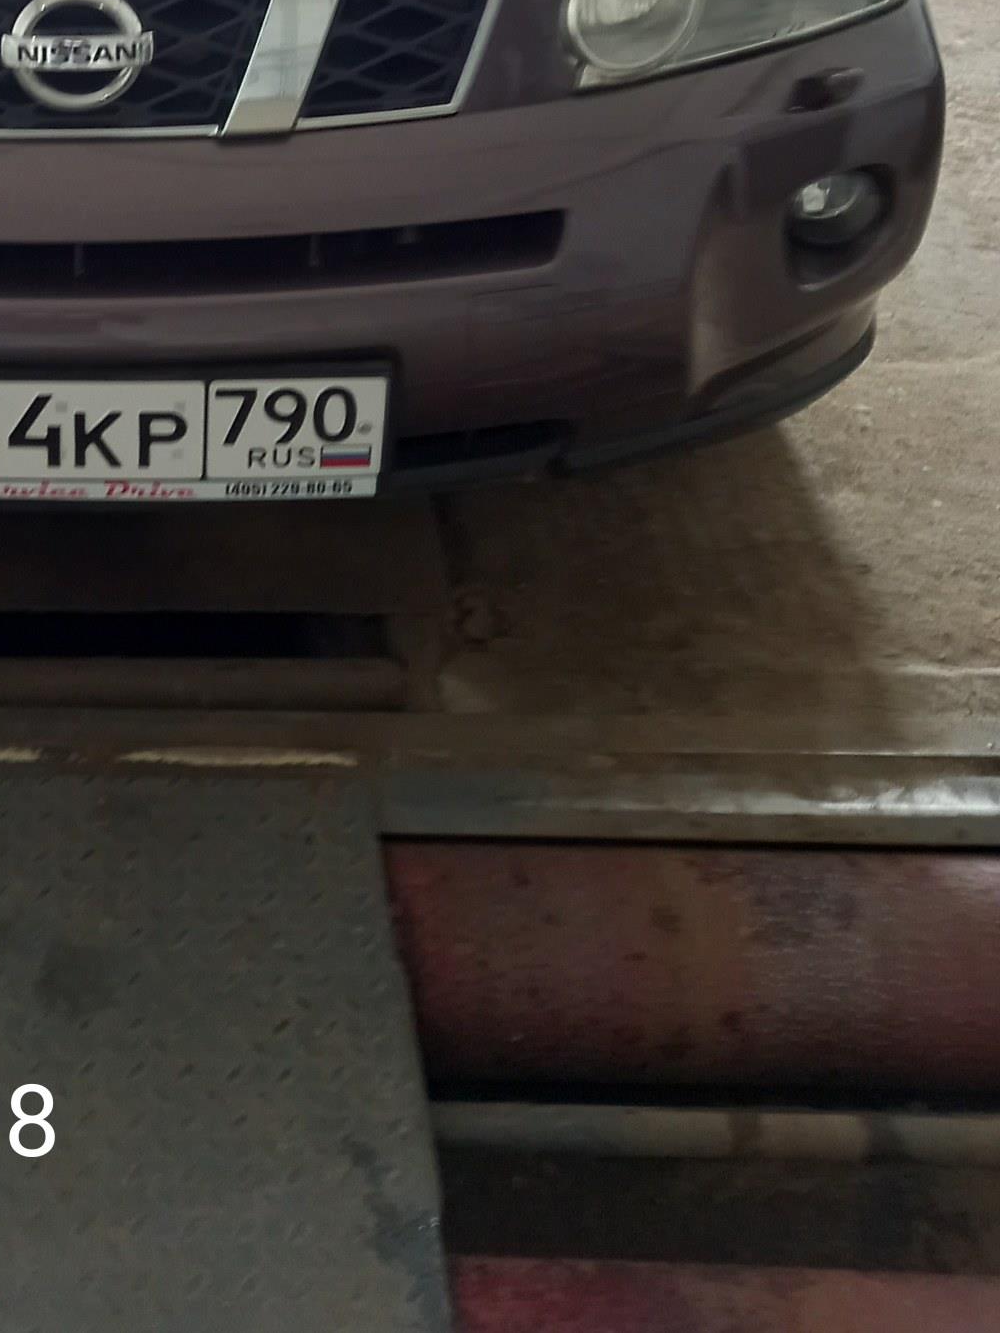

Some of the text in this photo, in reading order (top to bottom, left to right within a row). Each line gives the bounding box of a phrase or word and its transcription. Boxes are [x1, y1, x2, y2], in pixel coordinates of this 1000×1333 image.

[17, 42, 137, 64] NISSAN
[214, 386, 358, 446] 790
[247, 446, 316, 469] RUS
[103, 479, 195, 498] Drive
